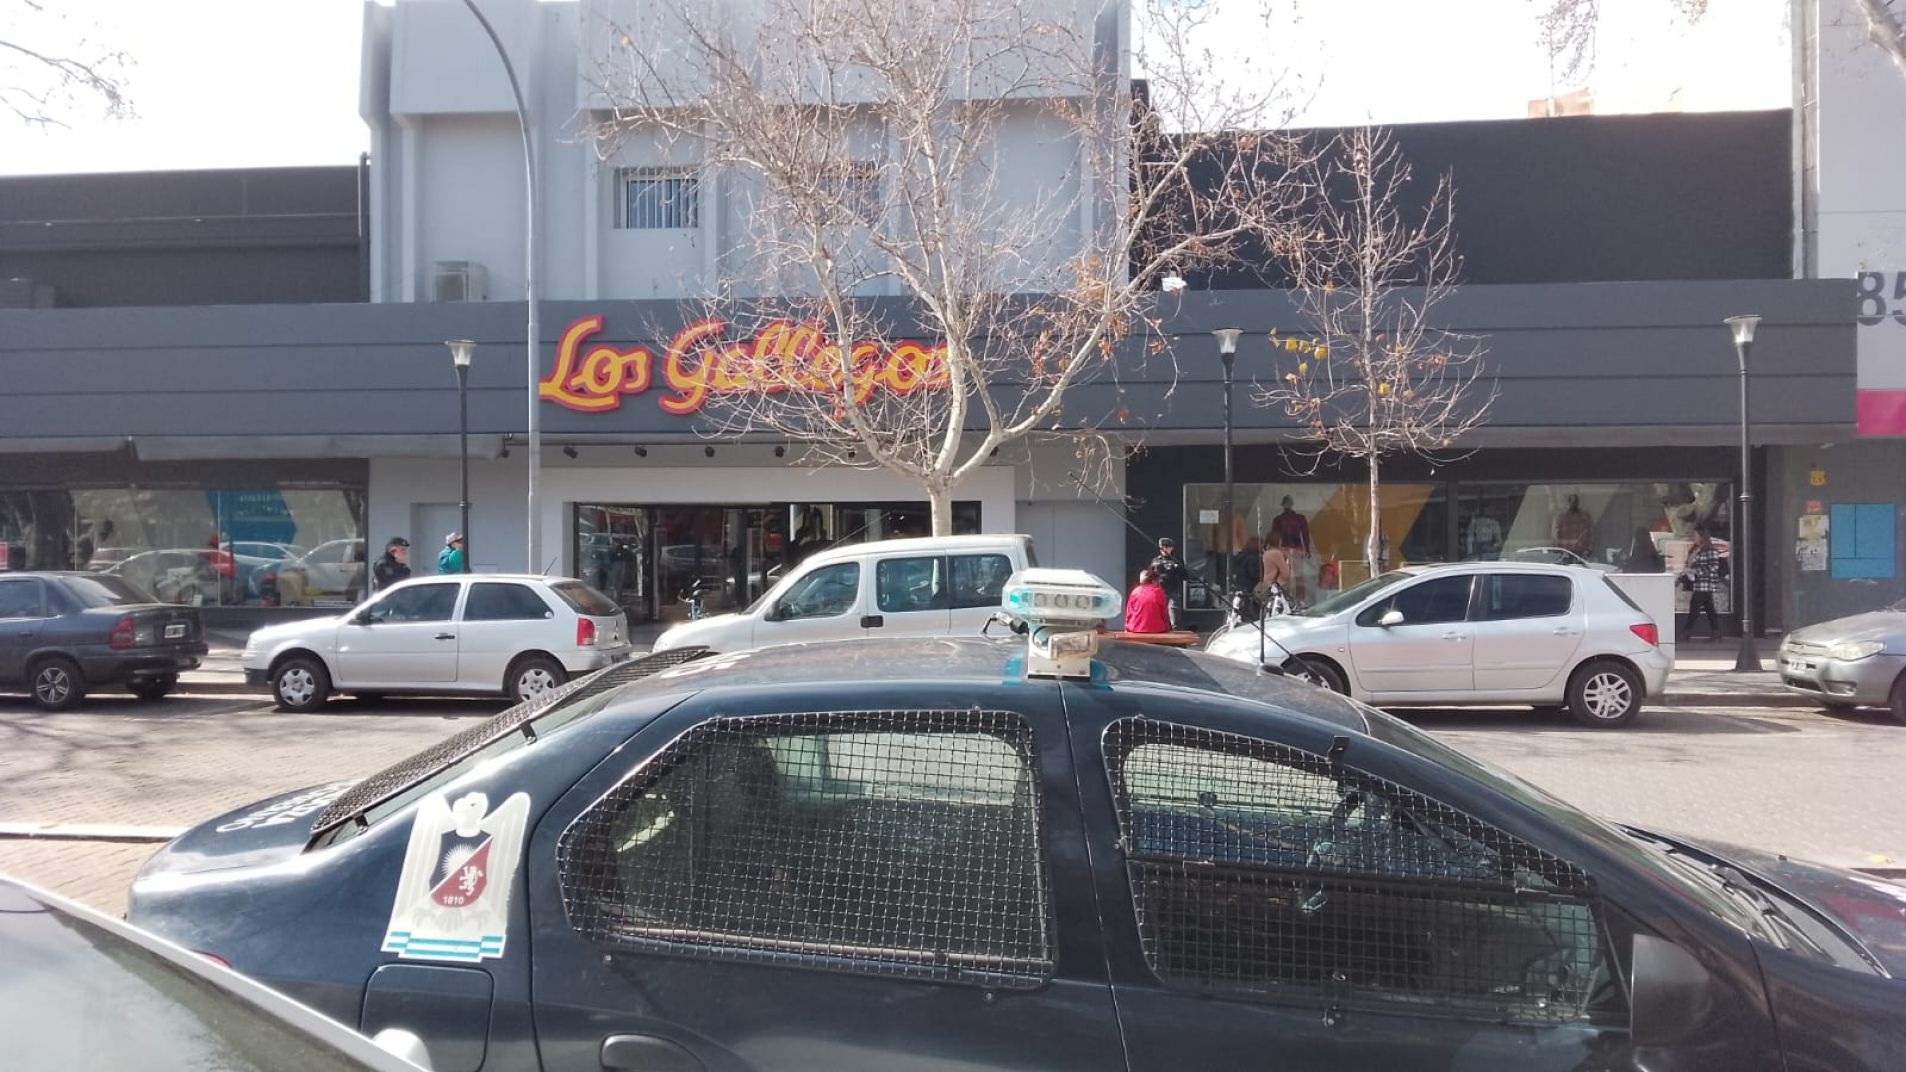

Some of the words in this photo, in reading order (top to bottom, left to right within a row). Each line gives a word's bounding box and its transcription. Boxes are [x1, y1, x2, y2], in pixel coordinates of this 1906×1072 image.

[540, 314, 652, 412] Los
[658, 317, 952, 415] Gallegos
[442, 896, 465, 905] 1810
